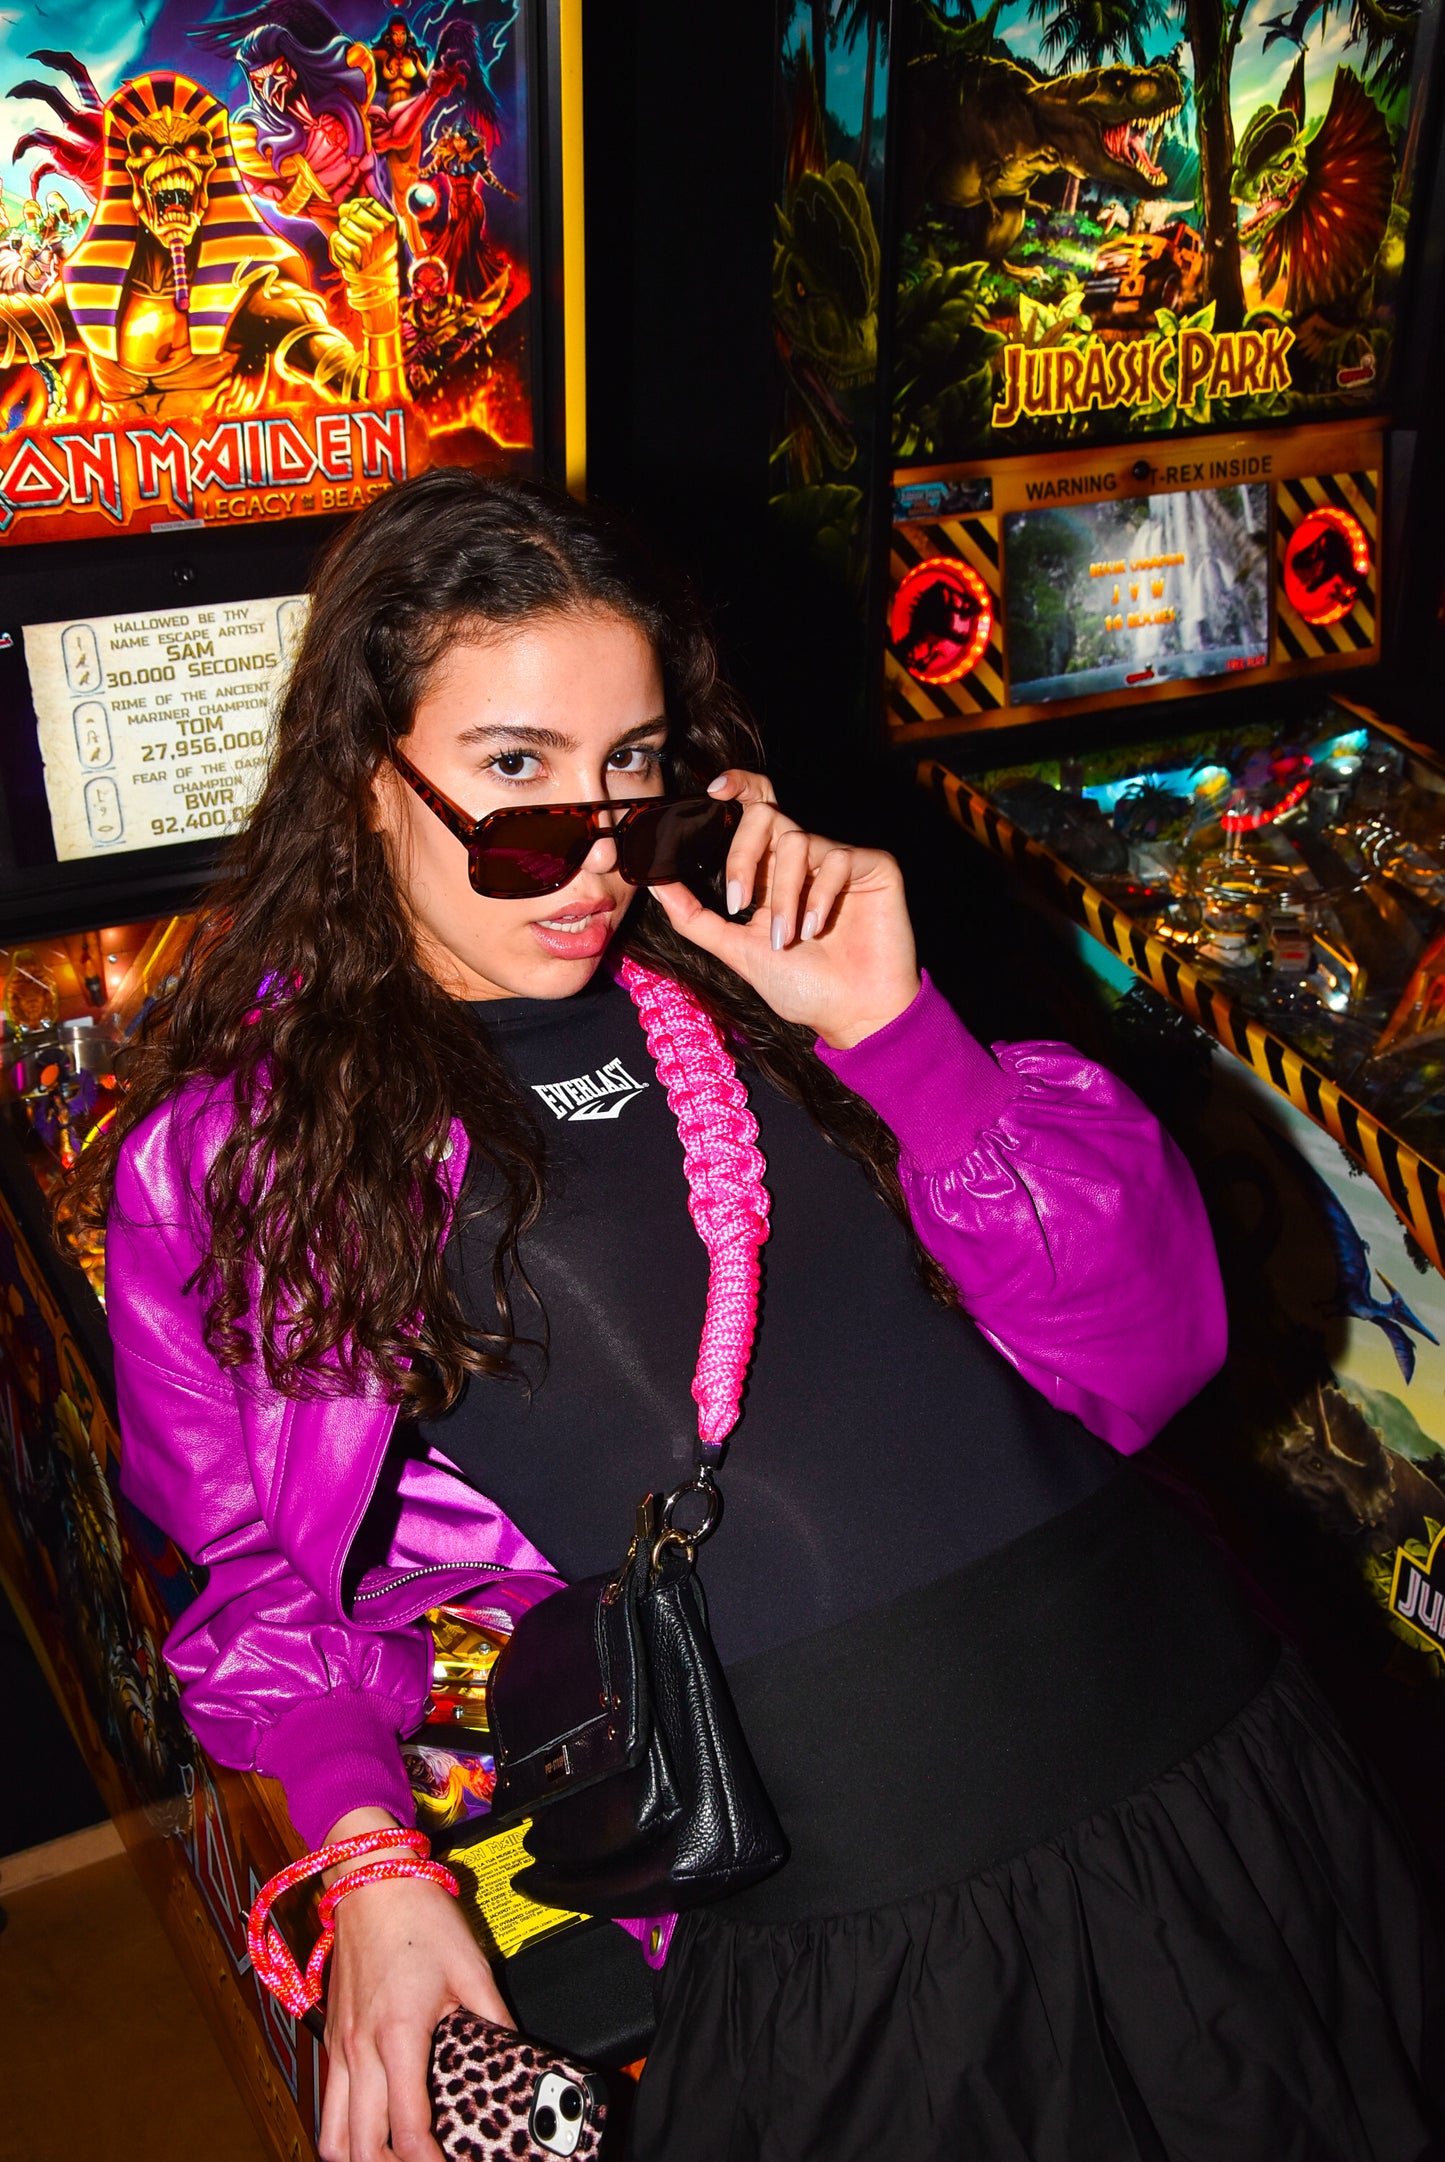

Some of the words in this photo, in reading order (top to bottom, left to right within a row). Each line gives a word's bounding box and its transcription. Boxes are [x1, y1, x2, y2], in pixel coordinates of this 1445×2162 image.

[991, 335, 1176, 428] JURASSIC
[1176, 326, 1297, 409] PARK
[0, 432, 122, 531] ON
[126, 409, 408, 519] MAIDEN
[1025, 472, 1117, 501] WARNING
[1209, 455, 1273, 478] INSIDE
[203, 492, 297, 521] LEGACY
[1128, 580, 1140, 602] V
[1150, 577, 1165, 599] W
[113, 615, 189, 634] HALLOWED
[198, 611, 216, 625] BE
[223, 608, 250, 621] THY
[110, 635, 150, 650] NAME
[158, 629, 210, 645] ESCAPE
[218, 622, 265, 638] ARTIST
[166, 640, 215, 662] SAM
[106, 665, 175, 689] 30.000
[188, 652, 278, 678] SECONDS
[111, 697, 147, 711] RIME
[155, 694, 173, 706] OF
[180, 690, 207, 704] THE
[215, 681, 270, 698] ANCIENT
[127, 707, 190, 726] MARINER
[199, 697, 268, 716] CHAMPION
[176, 715, 224, 737] TOM
[141, 730, 264, 762] 27,956,000
[132, 770, 167, 785] FEAR
[175, 767, 193, 779] OF
[201, 762, 227, 775] THE
[173, 776, 243, 795] CHAMPION
[185, 788, 235, 810] BWR
[530, 1057, 645, 1120] EVERLAST
